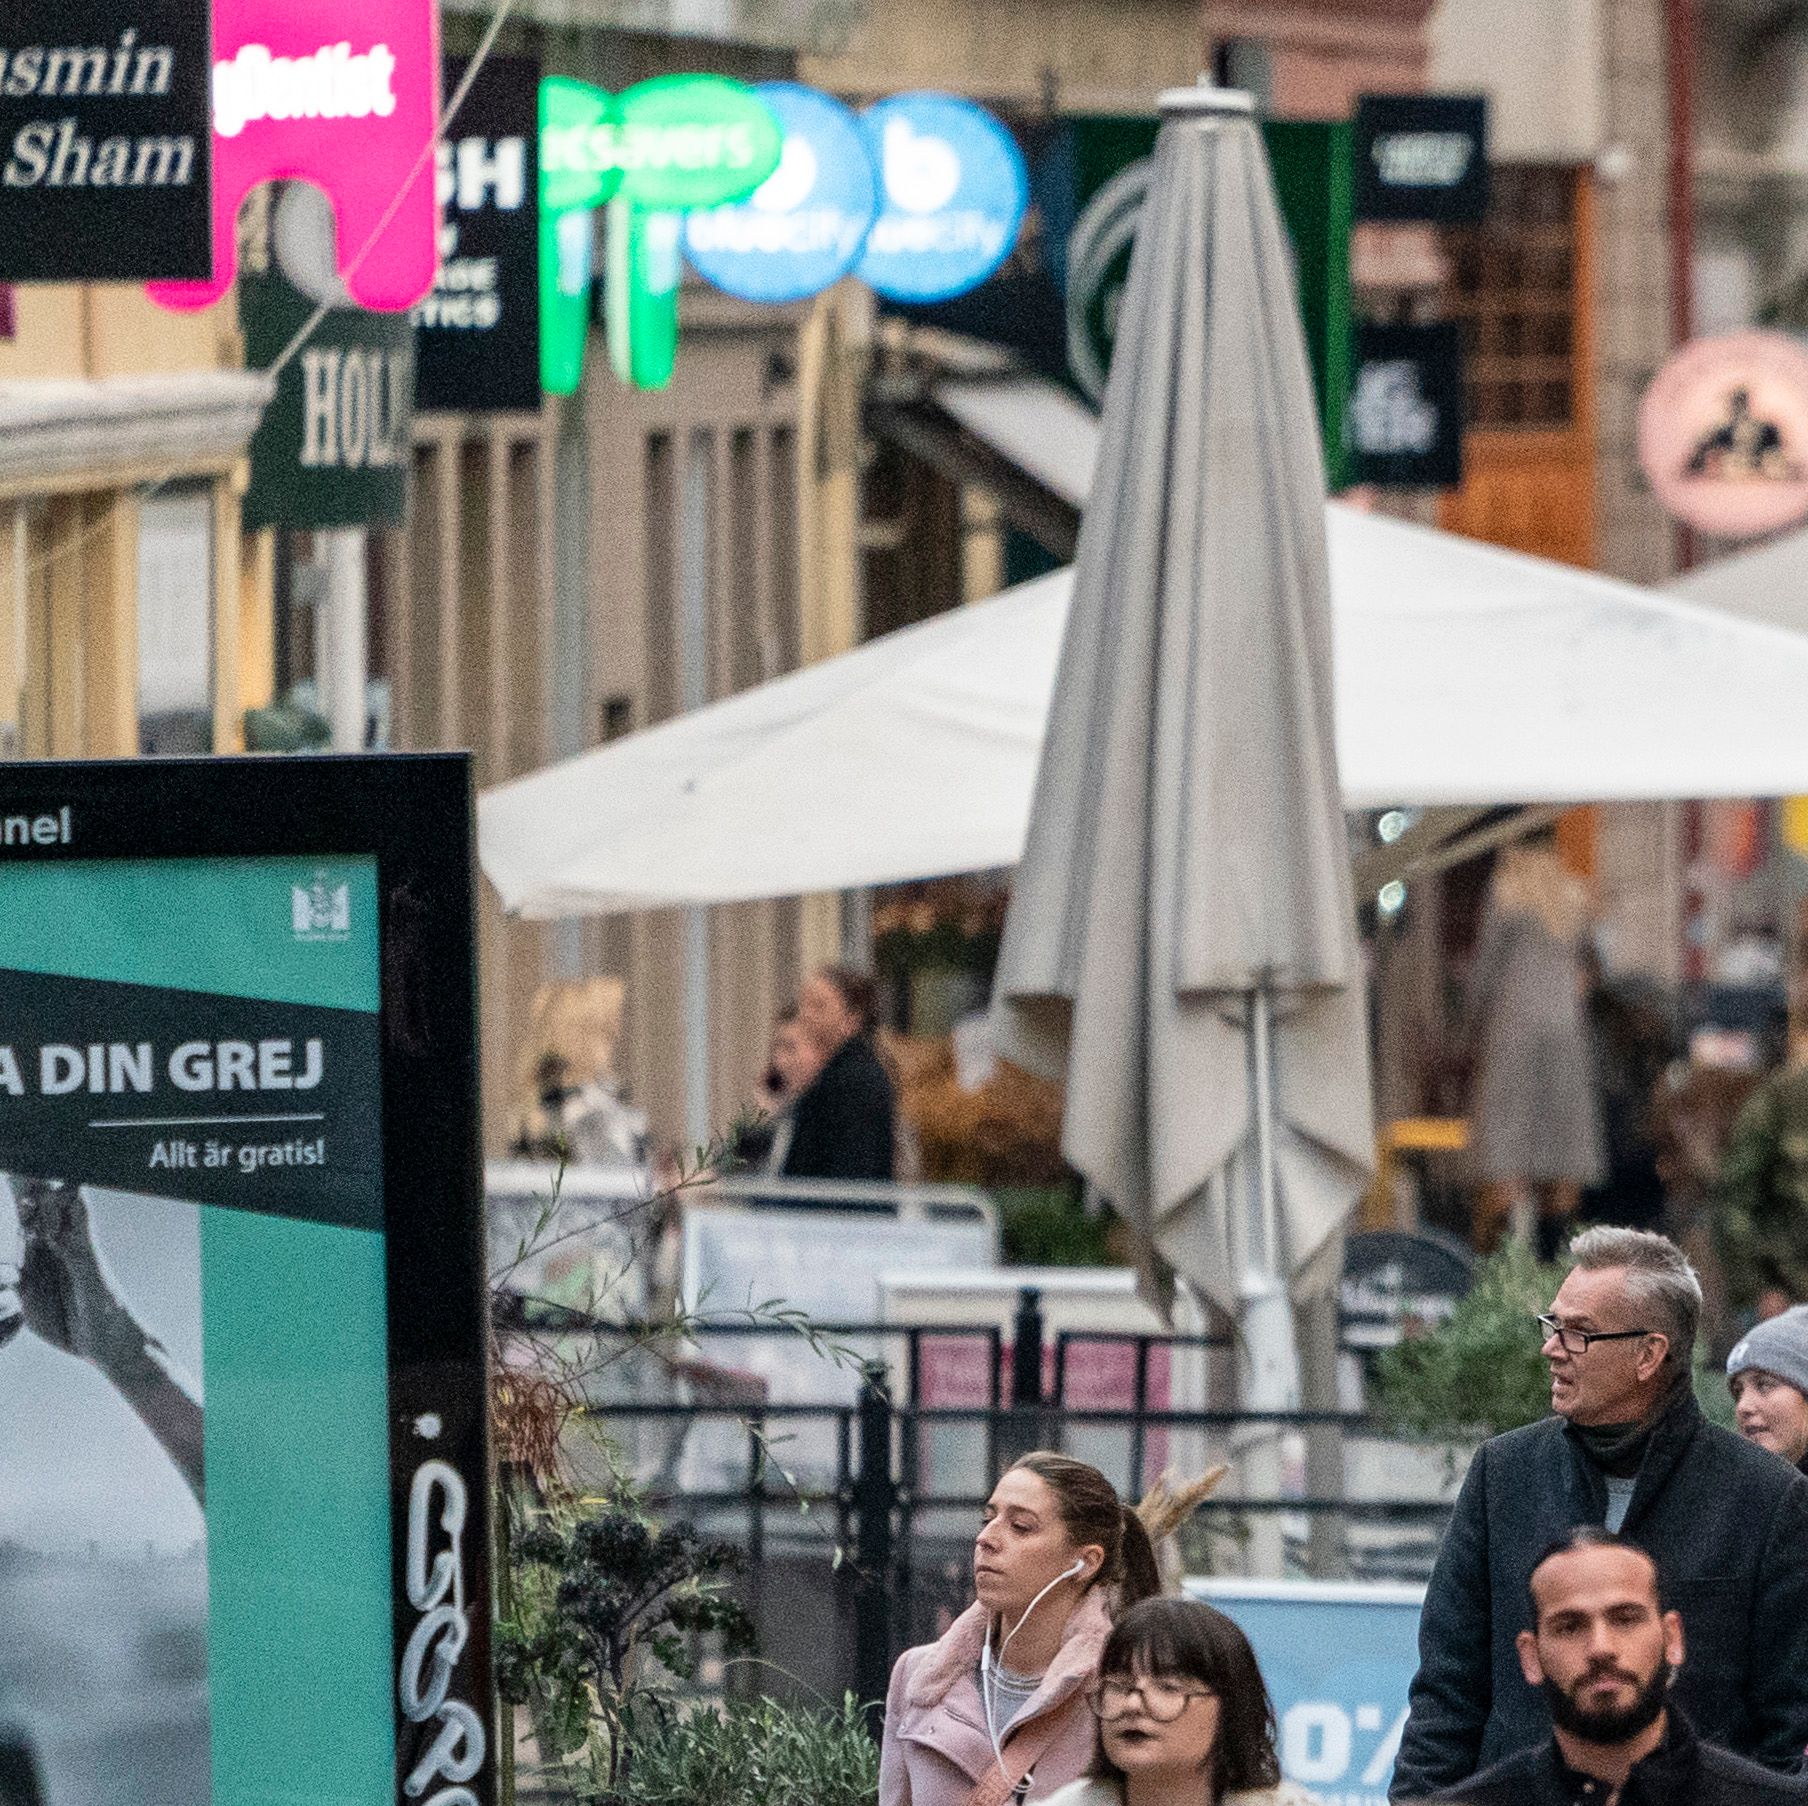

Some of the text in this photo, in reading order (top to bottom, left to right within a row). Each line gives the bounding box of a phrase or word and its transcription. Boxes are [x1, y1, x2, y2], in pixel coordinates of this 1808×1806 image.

[0, 27, 174, 96] smin
[3, 117, 195, 187] Sham
[0, 805, 72, 845] nel
[40, 1043, 153, 1095] DIN
[168, 1038, 325, 1091] GREJ
[149, 1139, 325, 1173] Allt är gratis!
